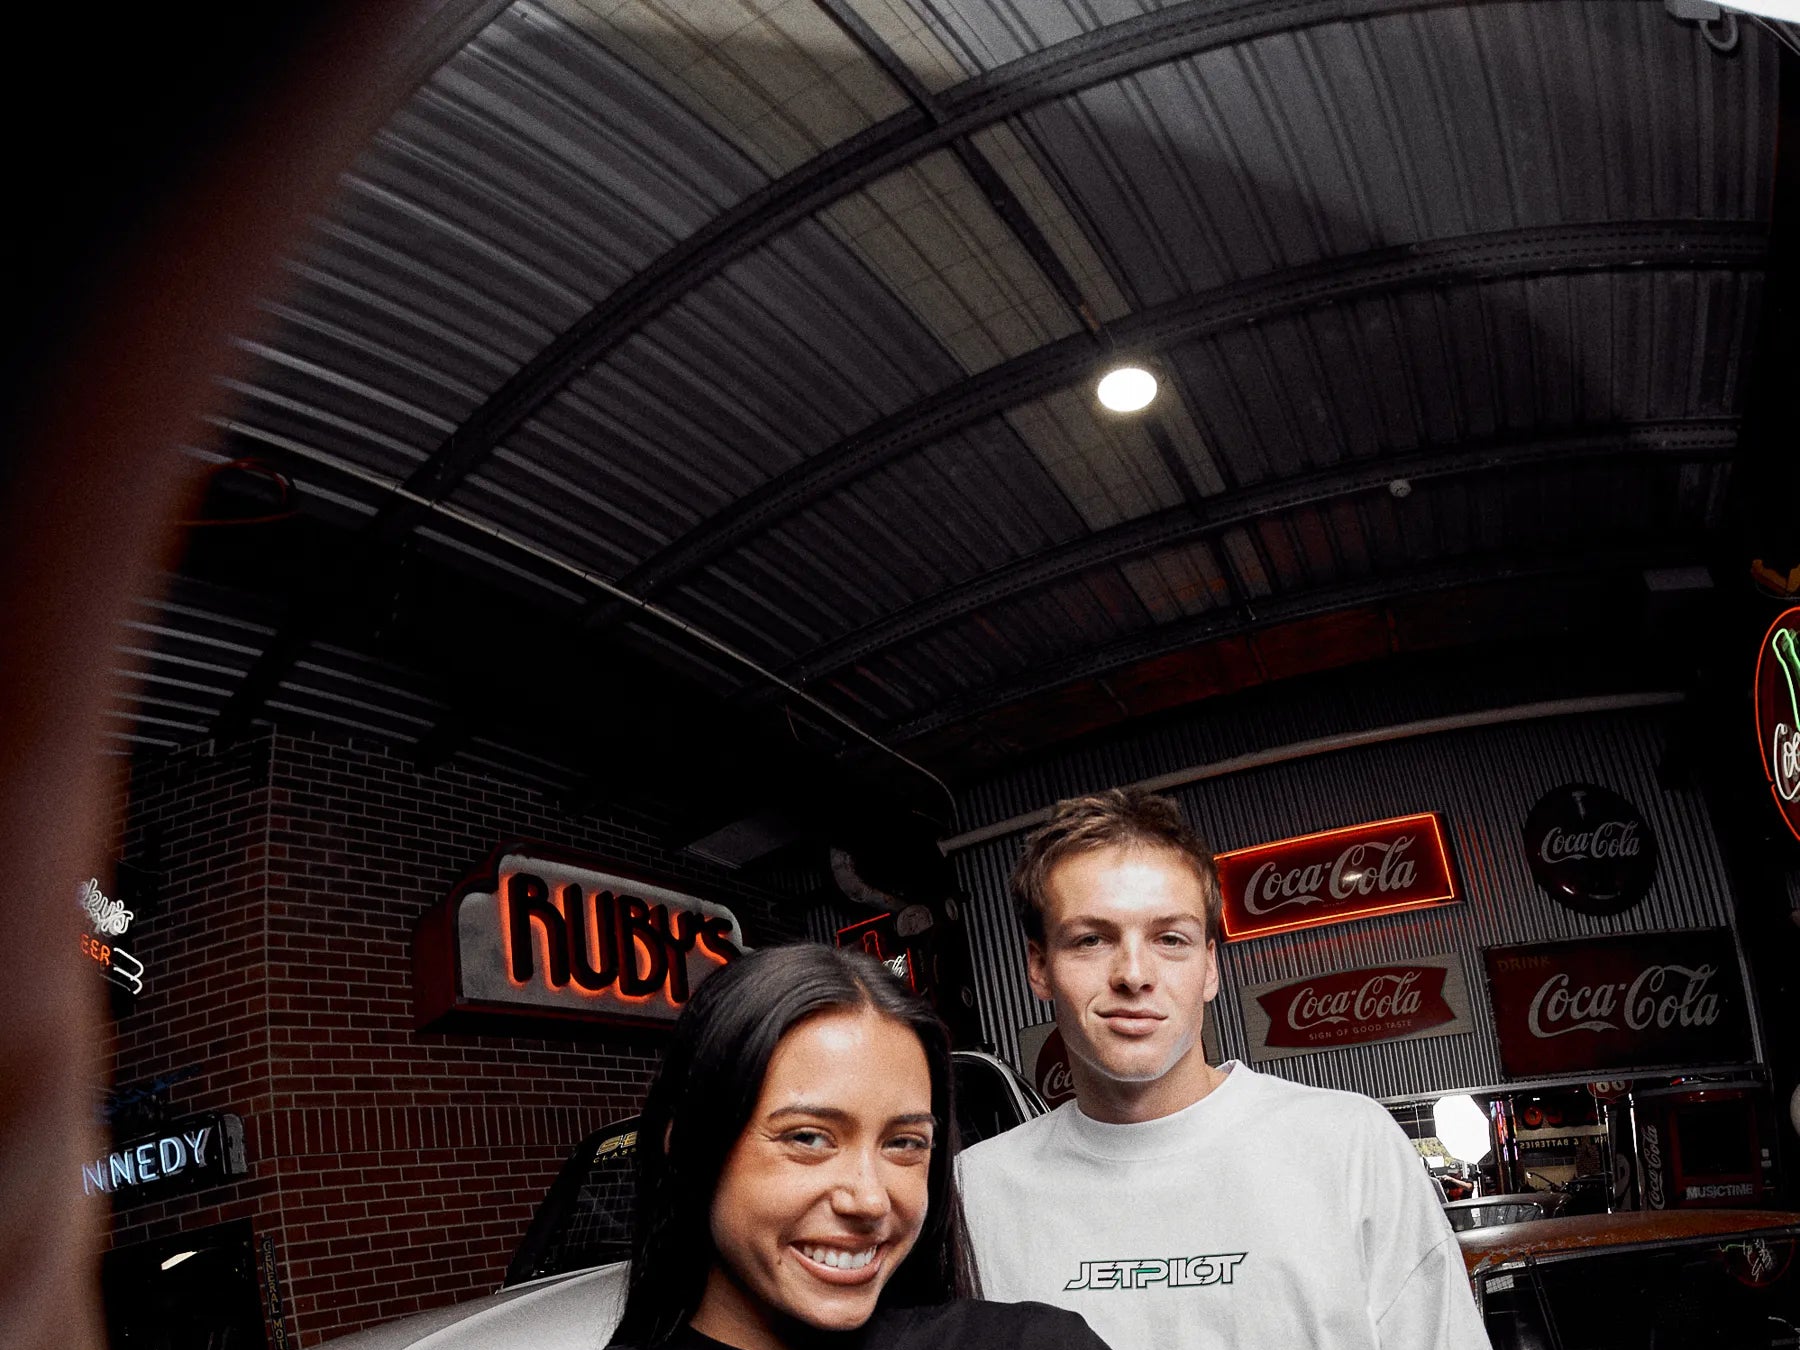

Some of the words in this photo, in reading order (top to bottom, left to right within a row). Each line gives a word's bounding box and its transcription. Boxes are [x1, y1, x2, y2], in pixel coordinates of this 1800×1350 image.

[1541, 820, 1640, 864] Coca-Cola
[1243, 833, 1418, 915] Coca-Cola
[1496, 955, 1551, 973] DRINK
[1287, 970, 1423, 1030] Coca-Cola
[1527, 963, 1720, 1038] Coca-Cola
[1308, 1031, 1332, 1041] SIGN
[1336, 1027, 1349, 1037] OF
[1353, 1024, 1382, 1034] GOOD
[1385, 1019, 1413, 1029] TASTE
[262, 1241, 280, 1314] GENERAL
[1063, 1252, 1248, 1291] JETPILOT
